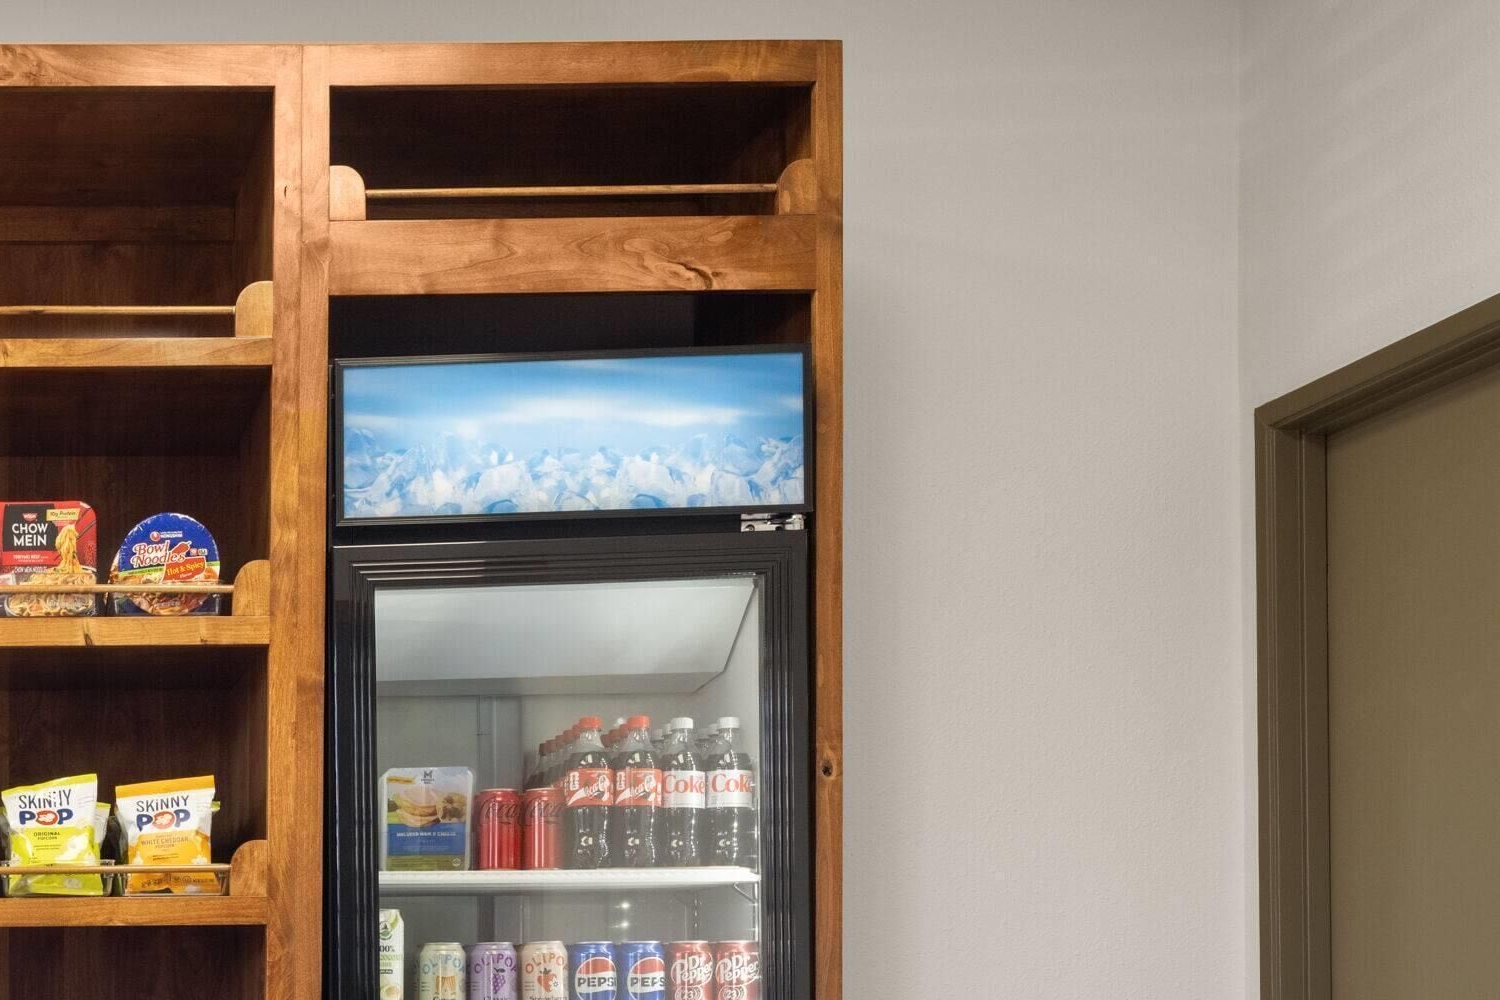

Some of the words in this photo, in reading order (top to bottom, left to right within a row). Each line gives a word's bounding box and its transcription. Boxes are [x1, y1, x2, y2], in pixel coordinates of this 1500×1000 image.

[11, 523, 48, 534] CHOW
[13, 534, 47, 547] MEIN
[133, 540, 170, 556] Bowl
[130, 550, 186, 568] Noodles
[166, 566, 179, 576] Hot
[186, 561, 204, 571] Spicy
[663, 773, 705, 794] Coke
[711, 773, 752, 794] Coke
[18, 808, 74, 826] POP
[136, 808, 191, 832] POP
[140, 838, 161, 846] WHITE
[160, 836, 189, 845] CHEDDAR
[688, 954, 706, 968] Dr
[733, 954, 750, 968] Dr
[675, 958, 713, 985] Pepper
[630, 976, 665, 988] PEPS
[682, 989, 694, 999] 23
